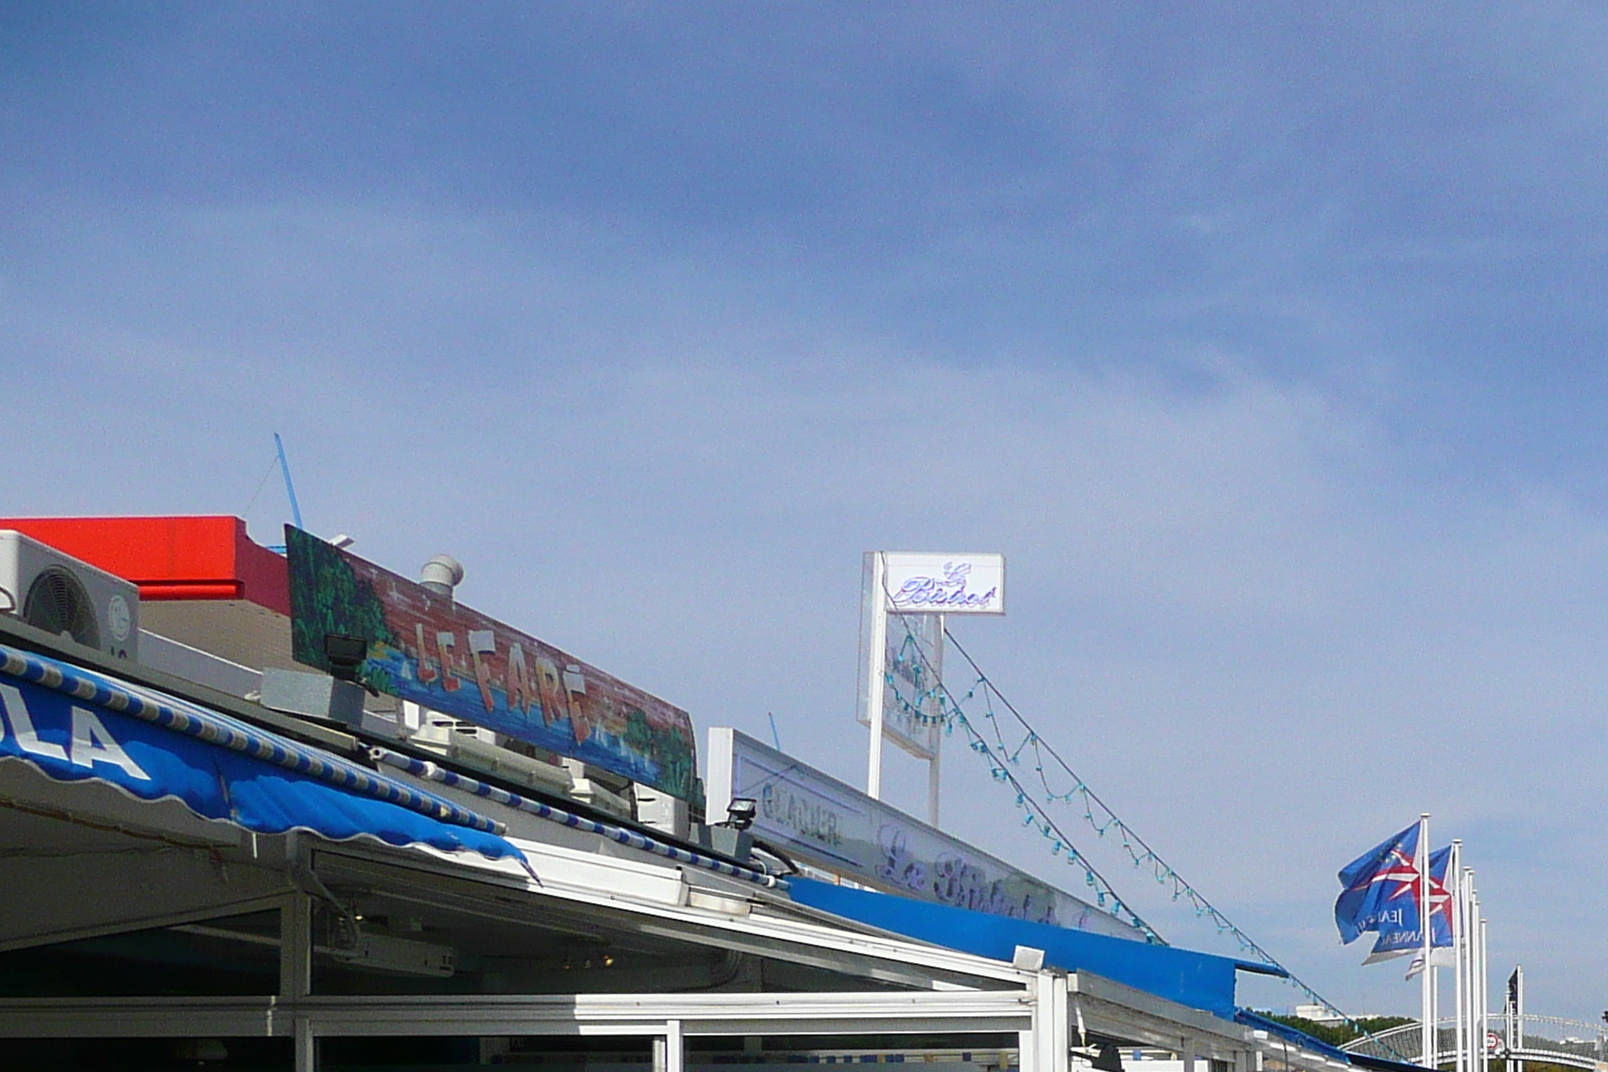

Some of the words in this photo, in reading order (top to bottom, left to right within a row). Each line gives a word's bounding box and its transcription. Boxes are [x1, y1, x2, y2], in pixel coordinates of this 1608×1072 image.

[893, 576, 997, 609] Bistrot
[416, 622, 462, 693] LE
[0, 682, 152, 781] LA
